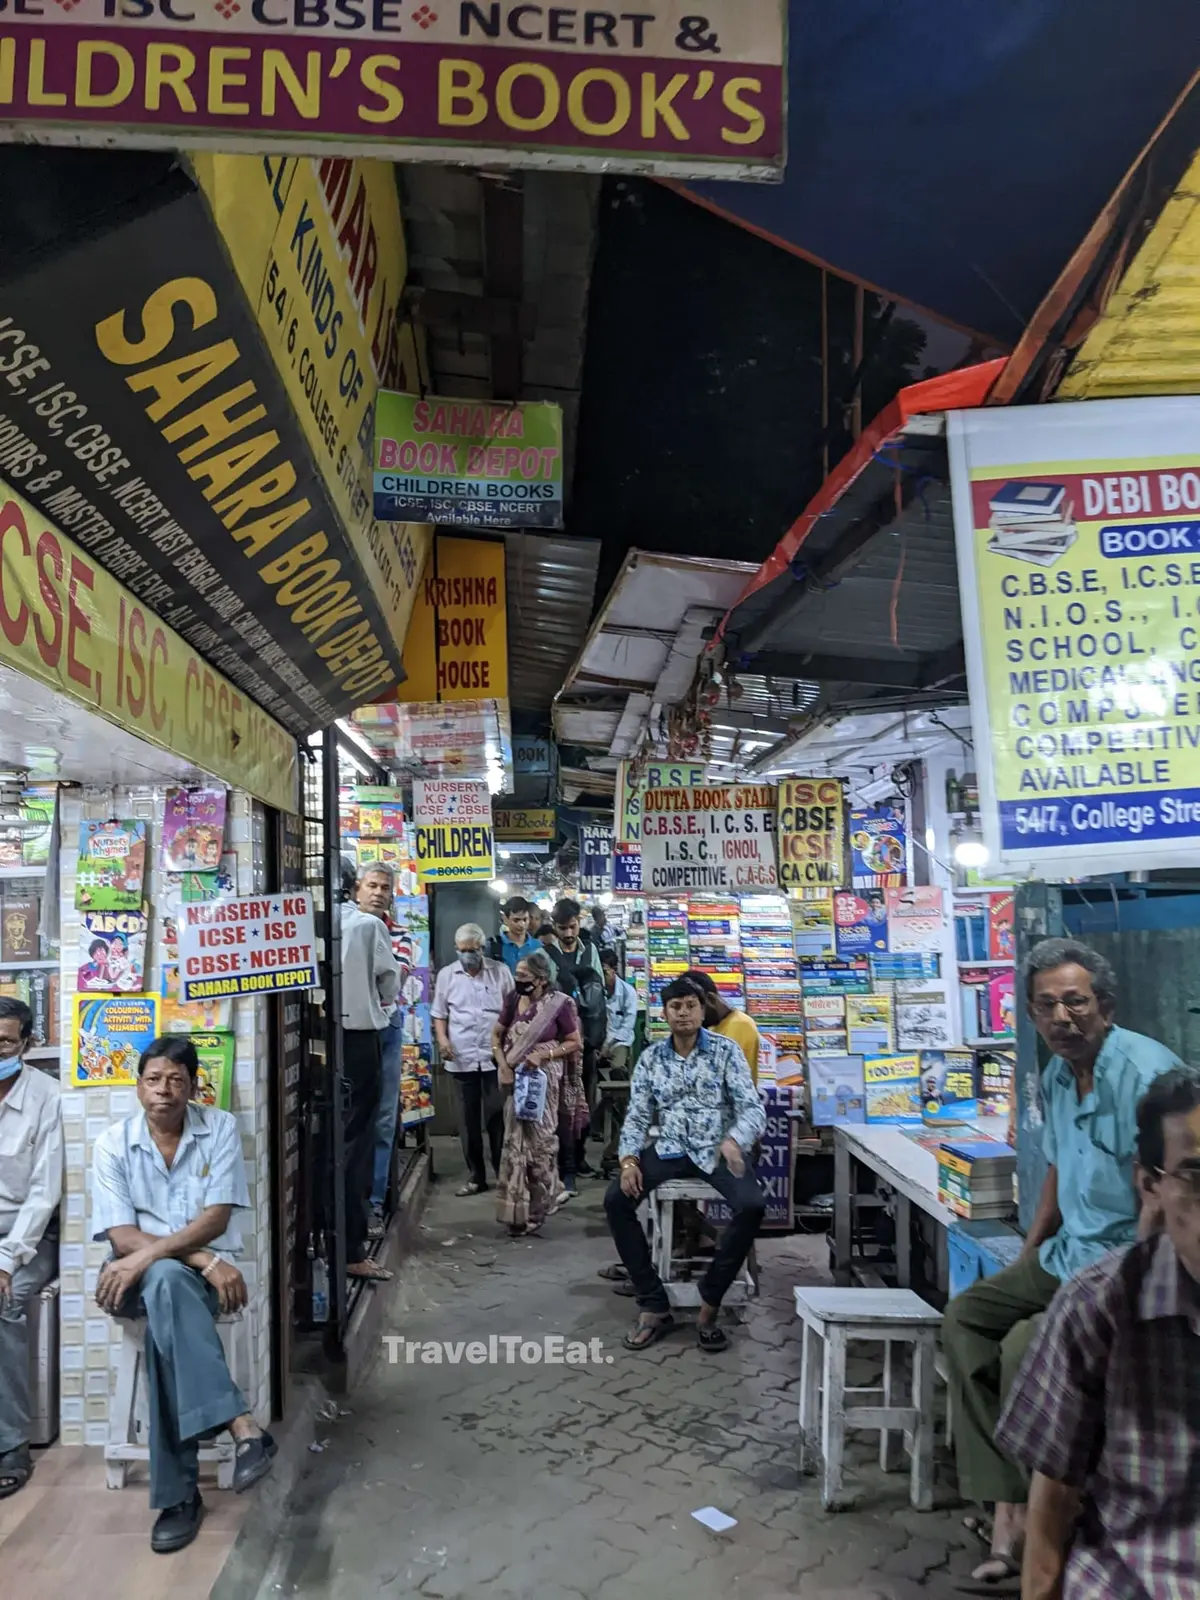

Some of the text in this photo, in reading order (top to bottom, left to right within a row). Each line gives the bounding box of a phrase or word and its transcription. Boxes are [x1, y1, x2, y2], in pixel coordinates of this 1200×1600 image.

[252, 0, 401, 32] CBSE
[459, 1, 656, 49] NCERT
[675, 16, 721, 53] &
[438, 59, 766, 144] BOOK'S
[290, 199, 343, 359] KINDS
[339, 348, 363, 409] OF
[299, 348, 340, 459] COLLEGE
[413, 400, 524, 438] SAHARA
[378, 438, 558, 479] BOOK DEPOT
[25, 470, 62, 493] &
[27, 382, 88, 437] ISC,
[65, 424, 130, 490] CBSE,
[110, 477, 170, 535] NCERT,
[148, 516, 192, 557] WEST
[172, 539, 222, 596] BENGAL
[96, 277, 313, 558] SAHARA
[258, 531, 365, 643] BOOK
[316, 610, 396, 699] DEPOT
[382, 476, 554, 499] CHILDREN BOOKS
[1082, 475, 1152, 516] DEBI
[394, 497, 541, 513] ICSE, ISC, CBSE, NCERT
[427, 512, 512, 526] Available Here
[40, 485, 115, 556] MASTER
[1103, 528, 1193, 553] BOOK
[424, 577, 498, 608] KRISHNA
[1002, 569, 1107, 598] C.B.S.E,
[1004, 600, 1147, 629] N.I.O.S.,
[439, 618, 486, 646] BOOK
[1006, 631, 1156, 662] SCHOOL,
[436, 661, 490, 689] HOUSE
[424, 783, 481, 792] NURSERY
[1019, 759, 1171, 792] AVAILABLE
[426, 795, 479, 804] K.G ISC
[644, 786, 777, 813] DUTTA BOOK STALL
[786, 782, 838, 805] ISC
[416, 805, 490, 815] ICSE CBSE
[782, 805, 836, 831] CBSE
[1071, 801, 1155, 834] College
[643, 815, 705, 838] C.B.S.E.,
[93, 847, 127, 856] Rhymes
[416, 827, 492, 860] CHILDREN
[722, 839, 761, 862] IGNOU,
[437, 867, 473, 876] BOOKS
[187, 898, 306, 925] NURSERY KG
[199, 921, 297, 947] ICSE ISC
[186, 945, 311, 976] CBSE NCERT
[188, 969, 312, 998] SAHARA BOOK DEPOT
